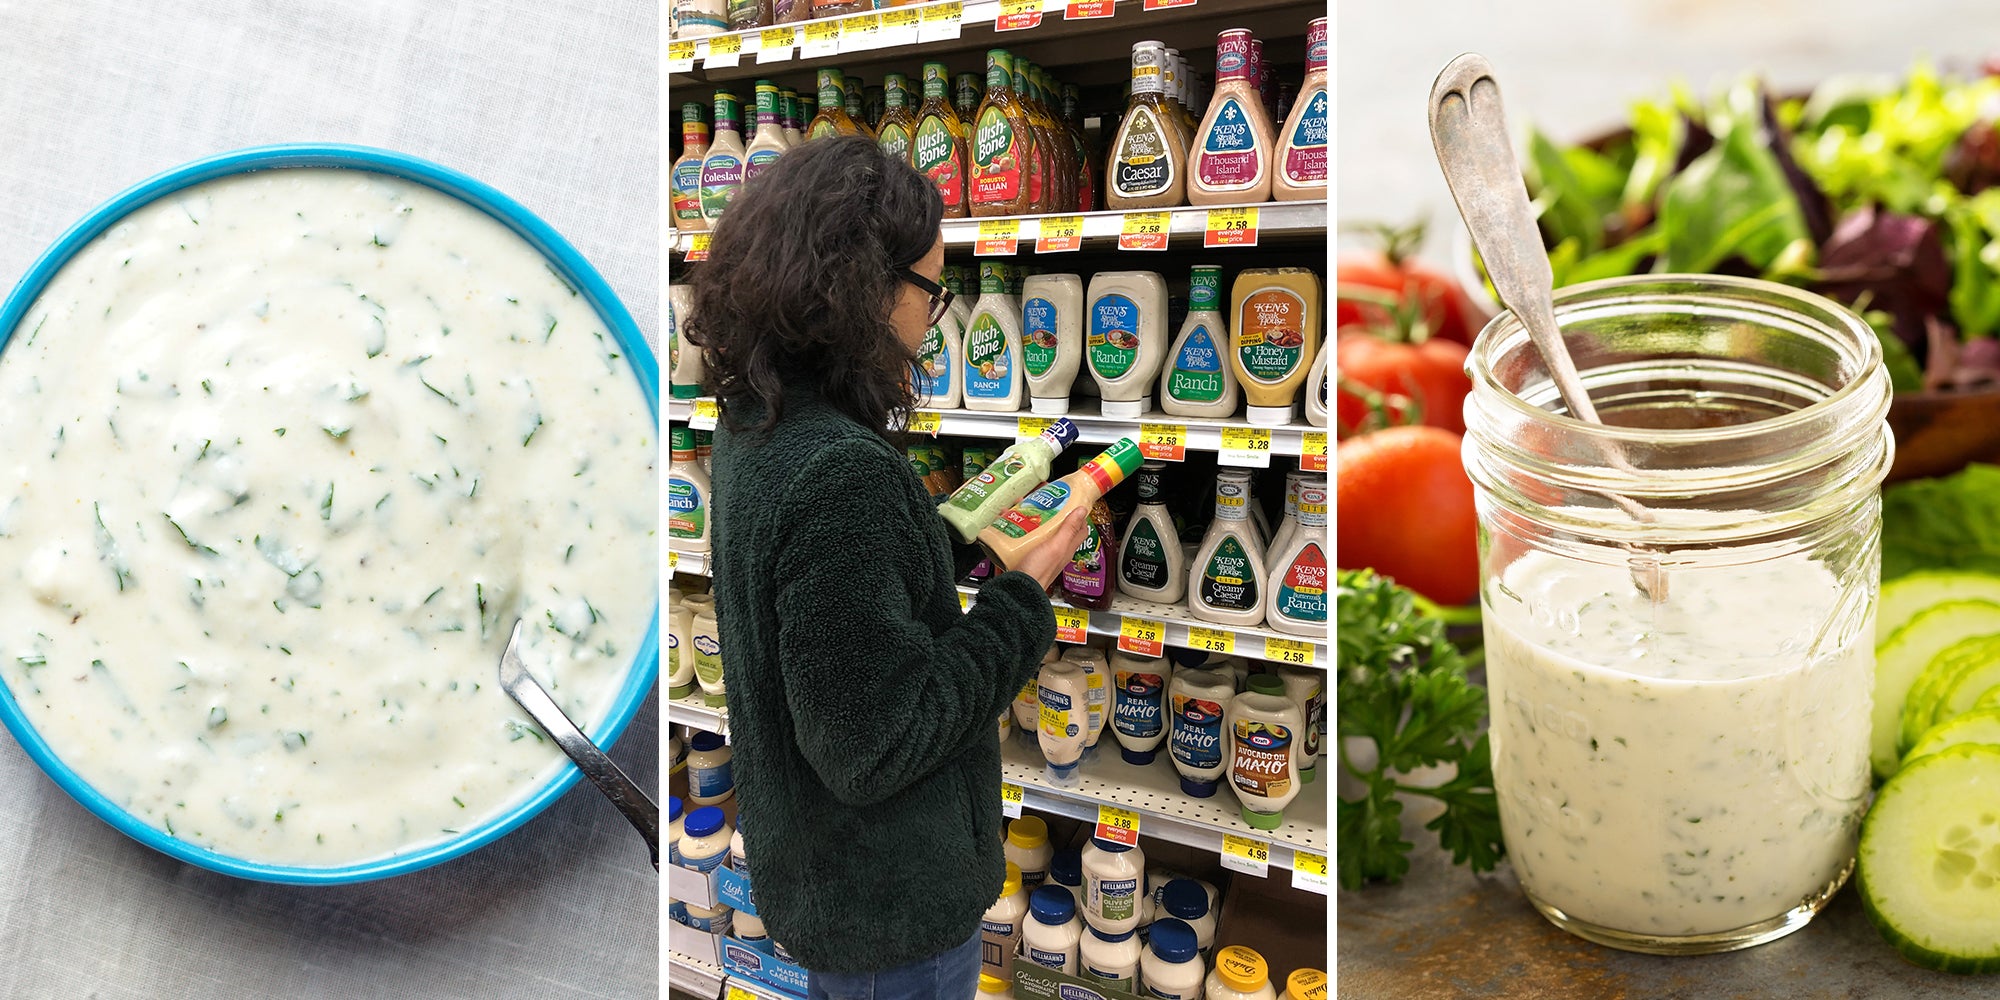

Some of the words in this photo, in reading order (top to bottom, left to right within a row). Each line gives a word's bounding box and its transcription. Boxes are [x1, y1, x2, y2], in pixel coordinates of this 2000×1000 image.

[1217, 40, 1249, 55] KEN'S
[1214, 123, 1246, 135] KEN'S
[1127, 132, 1156, 144] KEN'S
[1215, 133, 1237, 144] Steak
[1307, 131, 1327, 143] Hous
[978, 135, 1006, 162] Bone
[919, 143, 947, 168] Bone
[1208, 154, 1249, 166] Thousand
[1296, 151, 1327, 161] Thousa
[1122, 166, 1162, 182] Caesar
[1215, 164, 1241, 175] Island
[703, 171, 742, 183] Coleslaw
[979, 175, 1007, 184] ROBUSTO
[978, 182, 1008, 192] ITALIAN
[1226, 220, 1248, 230] 2.58
[1056, 229, 1074, 238] 1.98
[1190, 276, 1218, 288] KEN'S
[1098, 306, 1128, 317] KEN'S
[1254, 302, 1290, 314] KEN'S
[973, 339, 1000, 361] Bone
[1026, 349, 1048, 362] Ranch
[1184, 347, 1214, 358] KEN'S
[1255, 347, 1285, 357] Honey
[1095, 350, 1127, 365] Ranch
[1251, 355, 1288, 366] Mustard
[973, 381, 1000, 389] RANCH
[1174, 373, 1218, 391] Ranch
[1157, 437, 1177, 446] 2.58
[1247, 440, 1269, 450] 3.28
[1140, 474, 1160, 486] EN'S
[1007, 512, 1023, 523] SPICY
[1131, 535, 1157, 548] KEN'S
[1130, 558, 1159, 572] Creamy
[1215, 556, 1245, 567] KEN'S
[1131, 567, 1157, 579] Caesar
[1293, 565, 1326, 576] KEN'S
[1064, 576, 1100, 588] VINAIGRETTE
[1212, 583, 1245, 595] Creamy
[1214, 591, 1242, 601] Caesar
[1292, 592, 1321, 601] Buttermilk
[1288, 597, 1326, 612] Ranch
[1063, 619, 1081, 629] 1.98
[1137, 630, 1156, 640] 2.58
[1128, 638, 1152, 647] everyday
[1206, 640, 1225, 652] 2.58
[1283, 652, 1305, 663] 2.58
[1039, 689, 1069, 705] HELLMANN'S
[1116, 704, 1160, 718] MAYO
[1183, 724, 1207, 735] REAL
[1173, 729, 1218, 748] MAYO
[1238, 747, 1273, 760] AVOCADO
[1235, 756, 1288, 775] MAYO
[1114, 818, 1131, 829] 3.88
[1106, 826, 1128, 835] everyday
[1247, 848, 1268, 861] 4.98
[722, 880, 744, 896] Ligh
[1102, 881, 1136, 890] HELLMANN'S
[1031, 951, 1064, 962] HELLMANN'S
[777, 966, 799, 979] MADE
[769, 969, 791, 983] CAGE
[790, 978, 808, 989] FREE
[1016, 971, 1040, 985] Olive
[1041, 978, 1058, 989] Oil
[1020, 980, 1056, 994] MAYONNAISE
[1024, 986, 1051, 998] DRESSING
